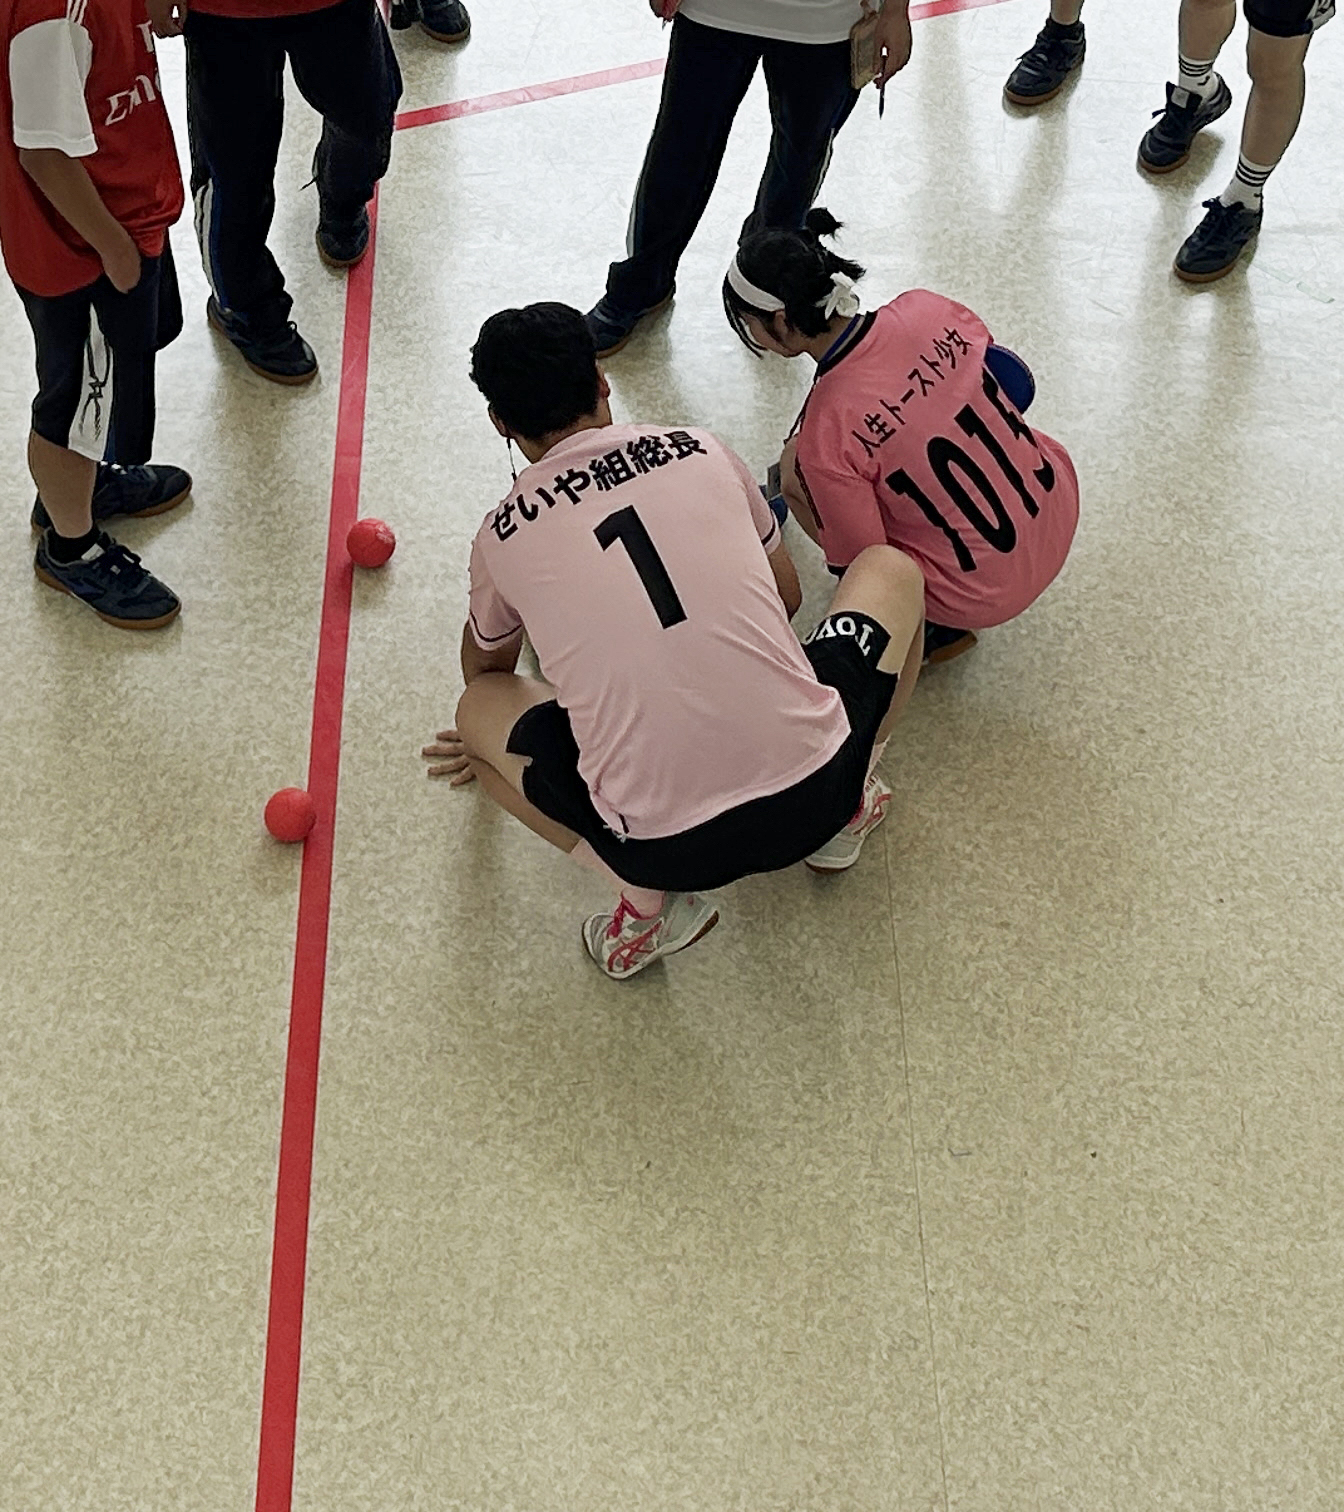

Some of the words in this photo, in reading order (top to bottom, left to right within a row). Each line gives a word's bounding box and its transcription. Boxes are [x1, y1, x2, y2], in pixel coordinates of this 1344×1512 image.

[851, 327, 972, 458] 人生トースト少女
[490, 430, 708, 542] せいや組総長
[593, 504, 688, 630] 1
